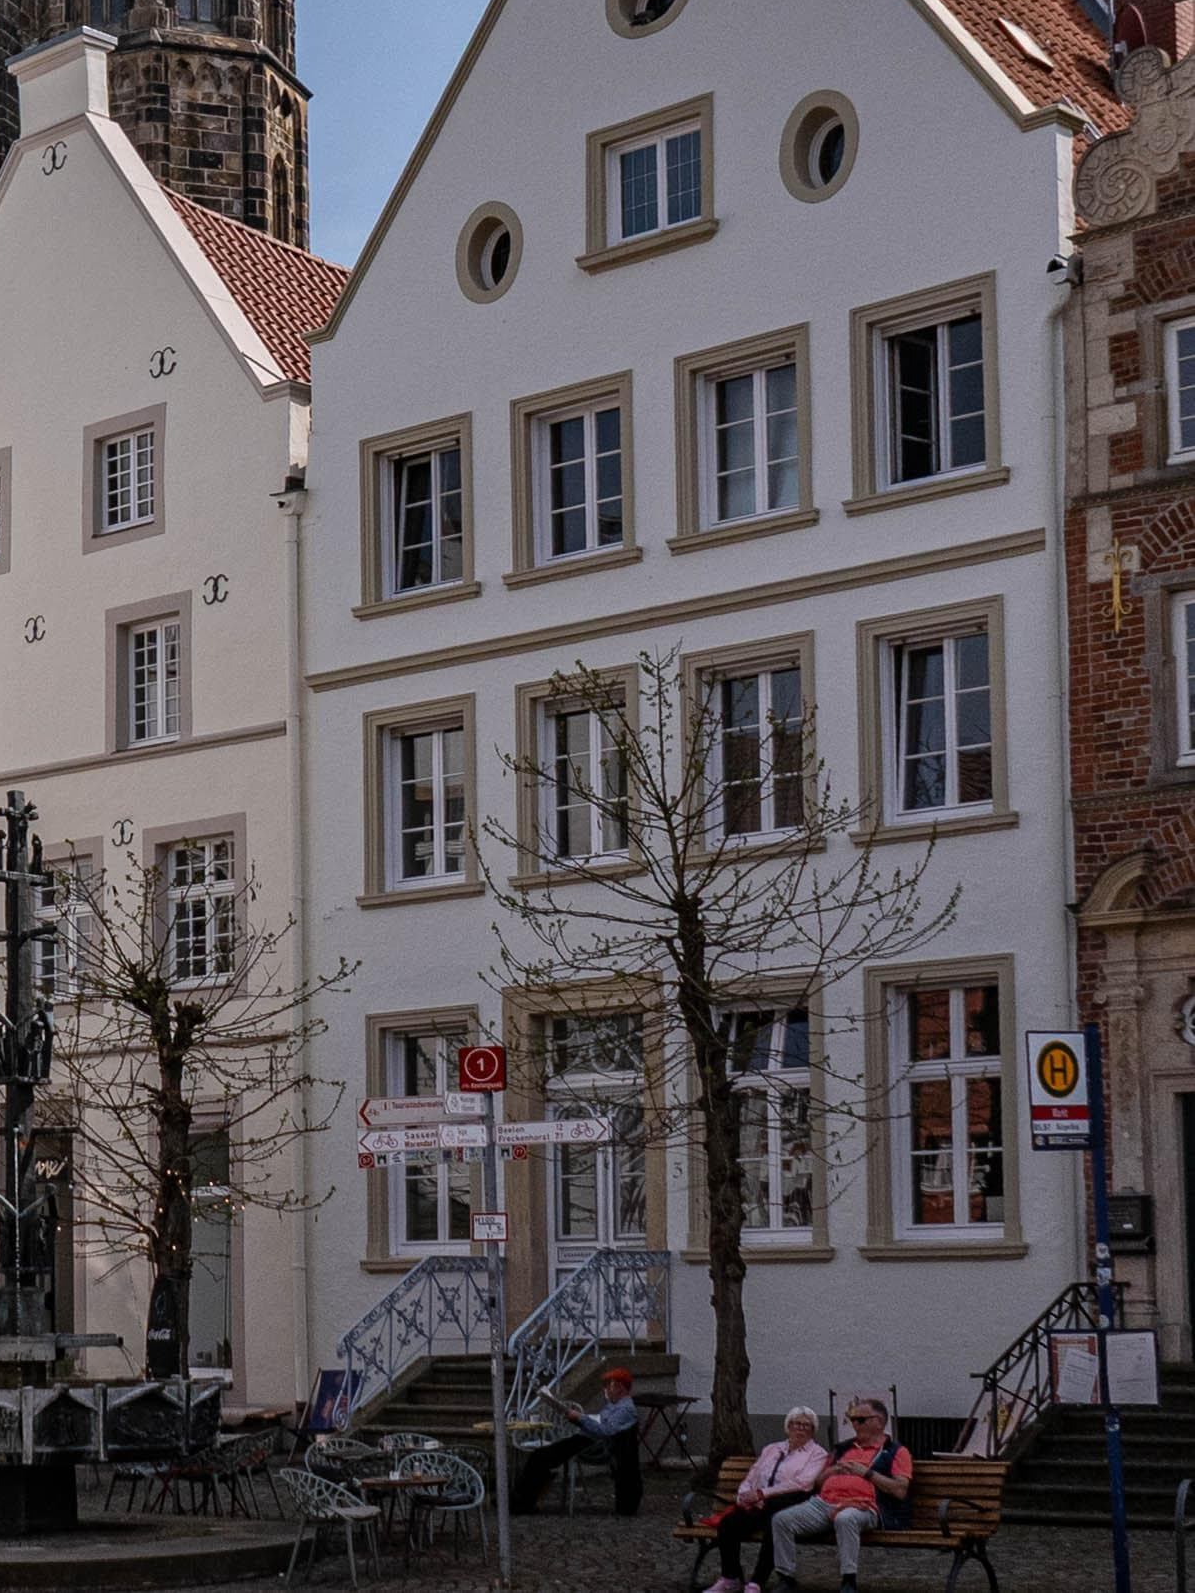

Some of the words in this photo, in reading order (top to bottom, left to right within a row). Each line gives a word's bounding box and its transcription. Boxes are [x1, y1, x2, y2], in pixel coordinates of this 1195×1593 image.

[476, 1057, 485, 1071] 1
[1049, 1054, 1068, 1086] H
[497, 1126, 525, 1134] Beelen
[405, 1131, 439, 1140] Sassen
[497, 1133, 551, 1143] Freckenhorst
[405, 1139, 437, 1149] Warendorf
[672, 1161, 683, 1179] 3
